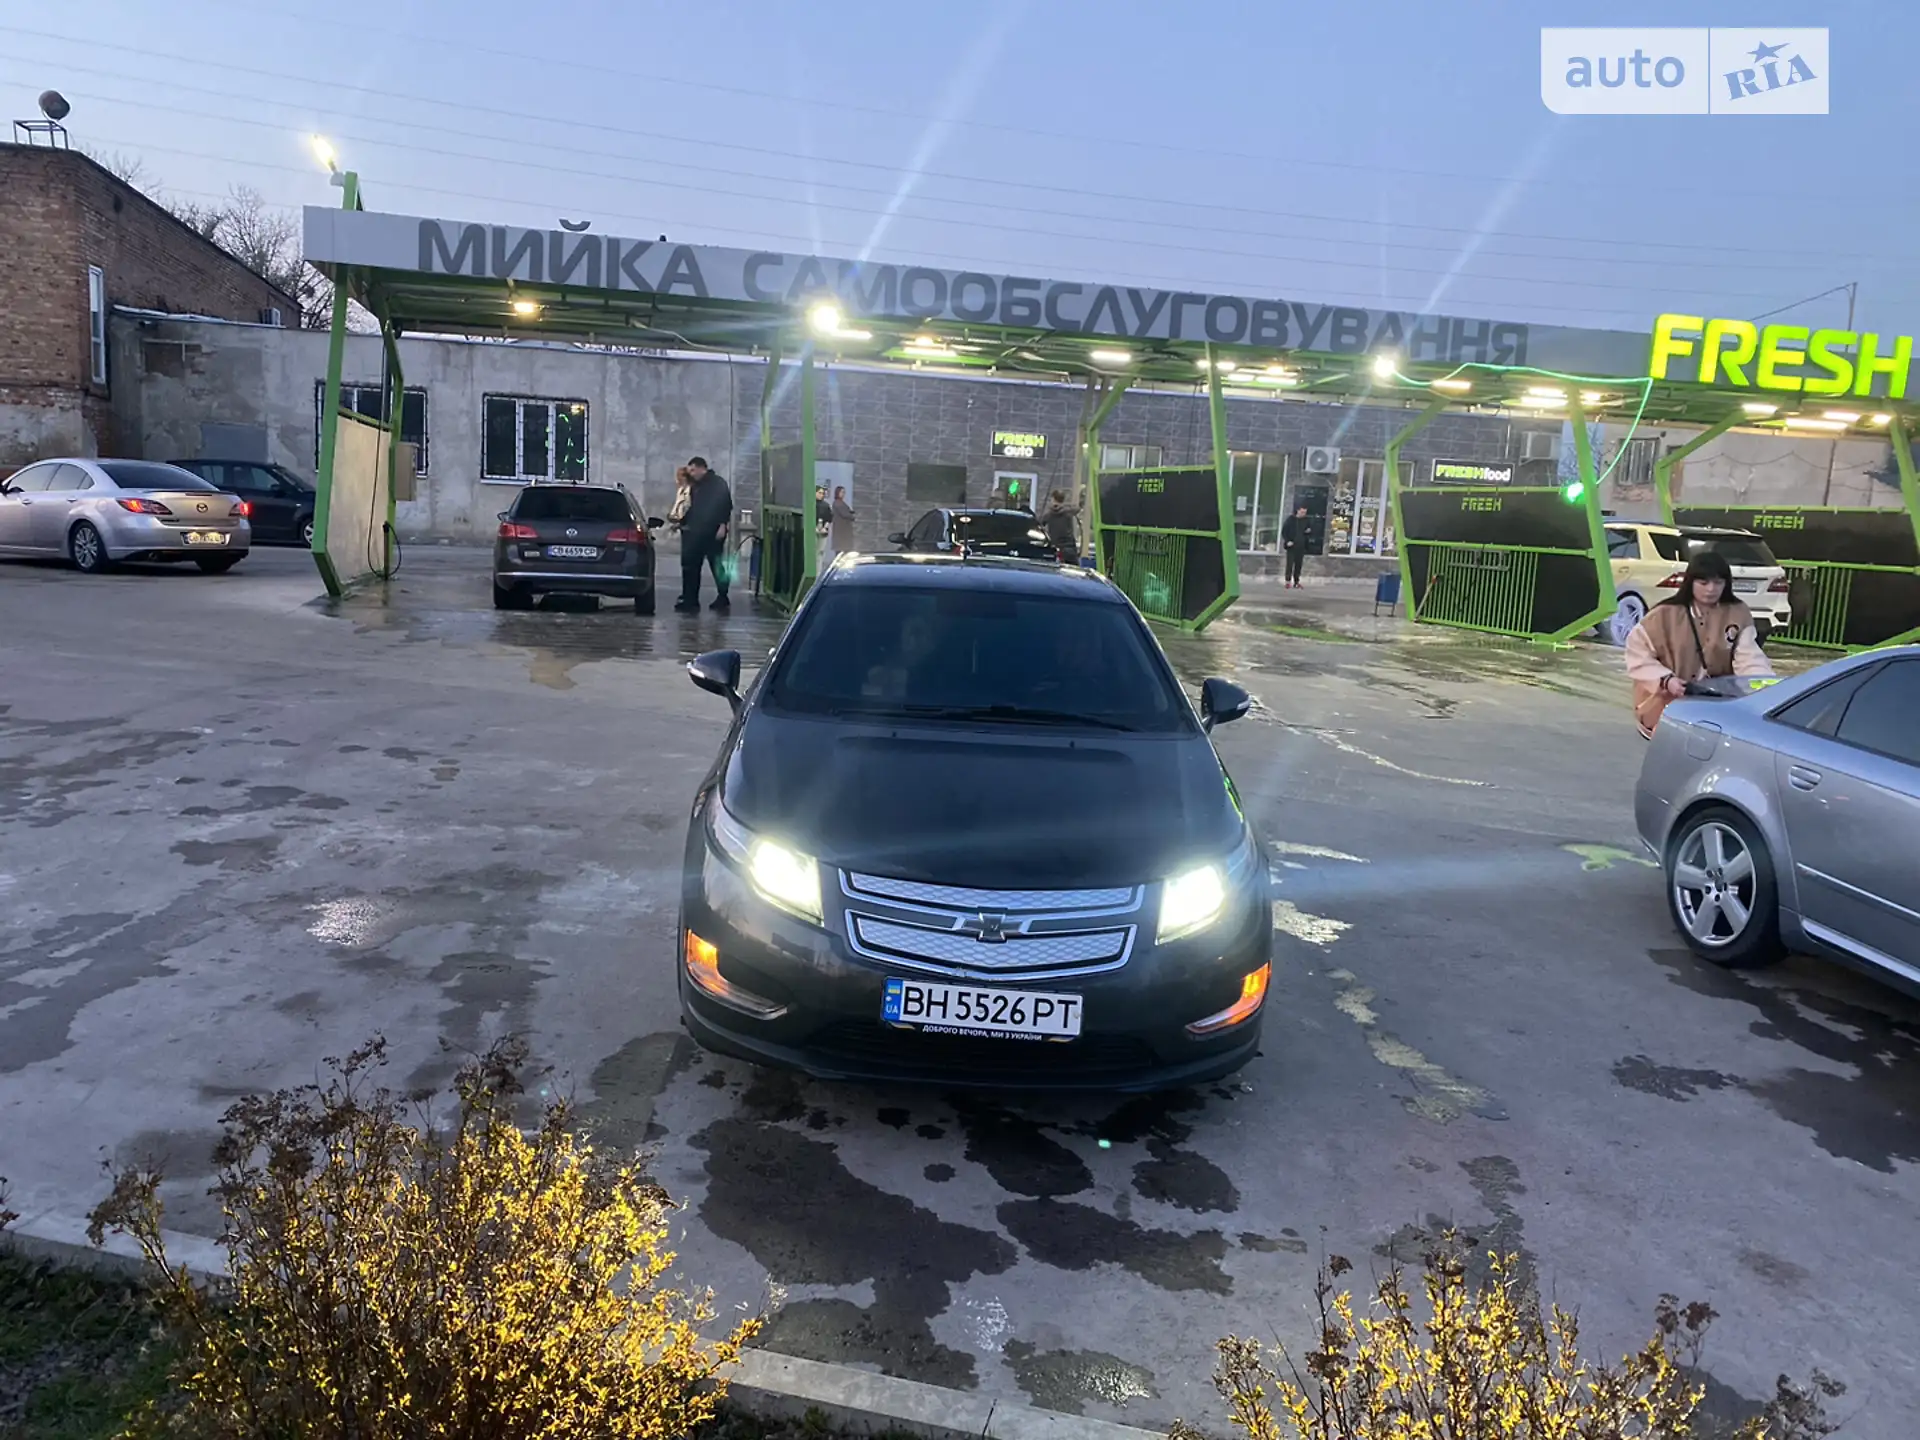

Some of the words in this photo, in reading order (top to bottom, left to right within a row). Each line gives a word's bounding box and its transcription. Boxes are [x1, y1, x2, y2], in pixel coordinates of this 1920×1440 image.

[417, 217, 711, 298] МИЙКА
[742, 251, 1529, 368] САМООБСЛУГОВУВАННЯ
[1650, 313, 1914, 399] FRESH
[994, 432, 1045, 448] FRESH
[1003, 445, 1034, 458] auto
[1136, 478, 1165, 493] FRESH
[1461, 497, 1502, 511] FRESH
[1753, 514, 1805, 530] FRESH
[886, 1004, 899, 1014] UA
[903, 986, 949, 1019] BH
[954, 990, 1027, 1026] 5526
[1032, 998, 1078, 1029] PT
[922, 1024, 958, 1035] ДОБРОГО
[1011, 1032, 1042, 1041] УКРАЇНИ
